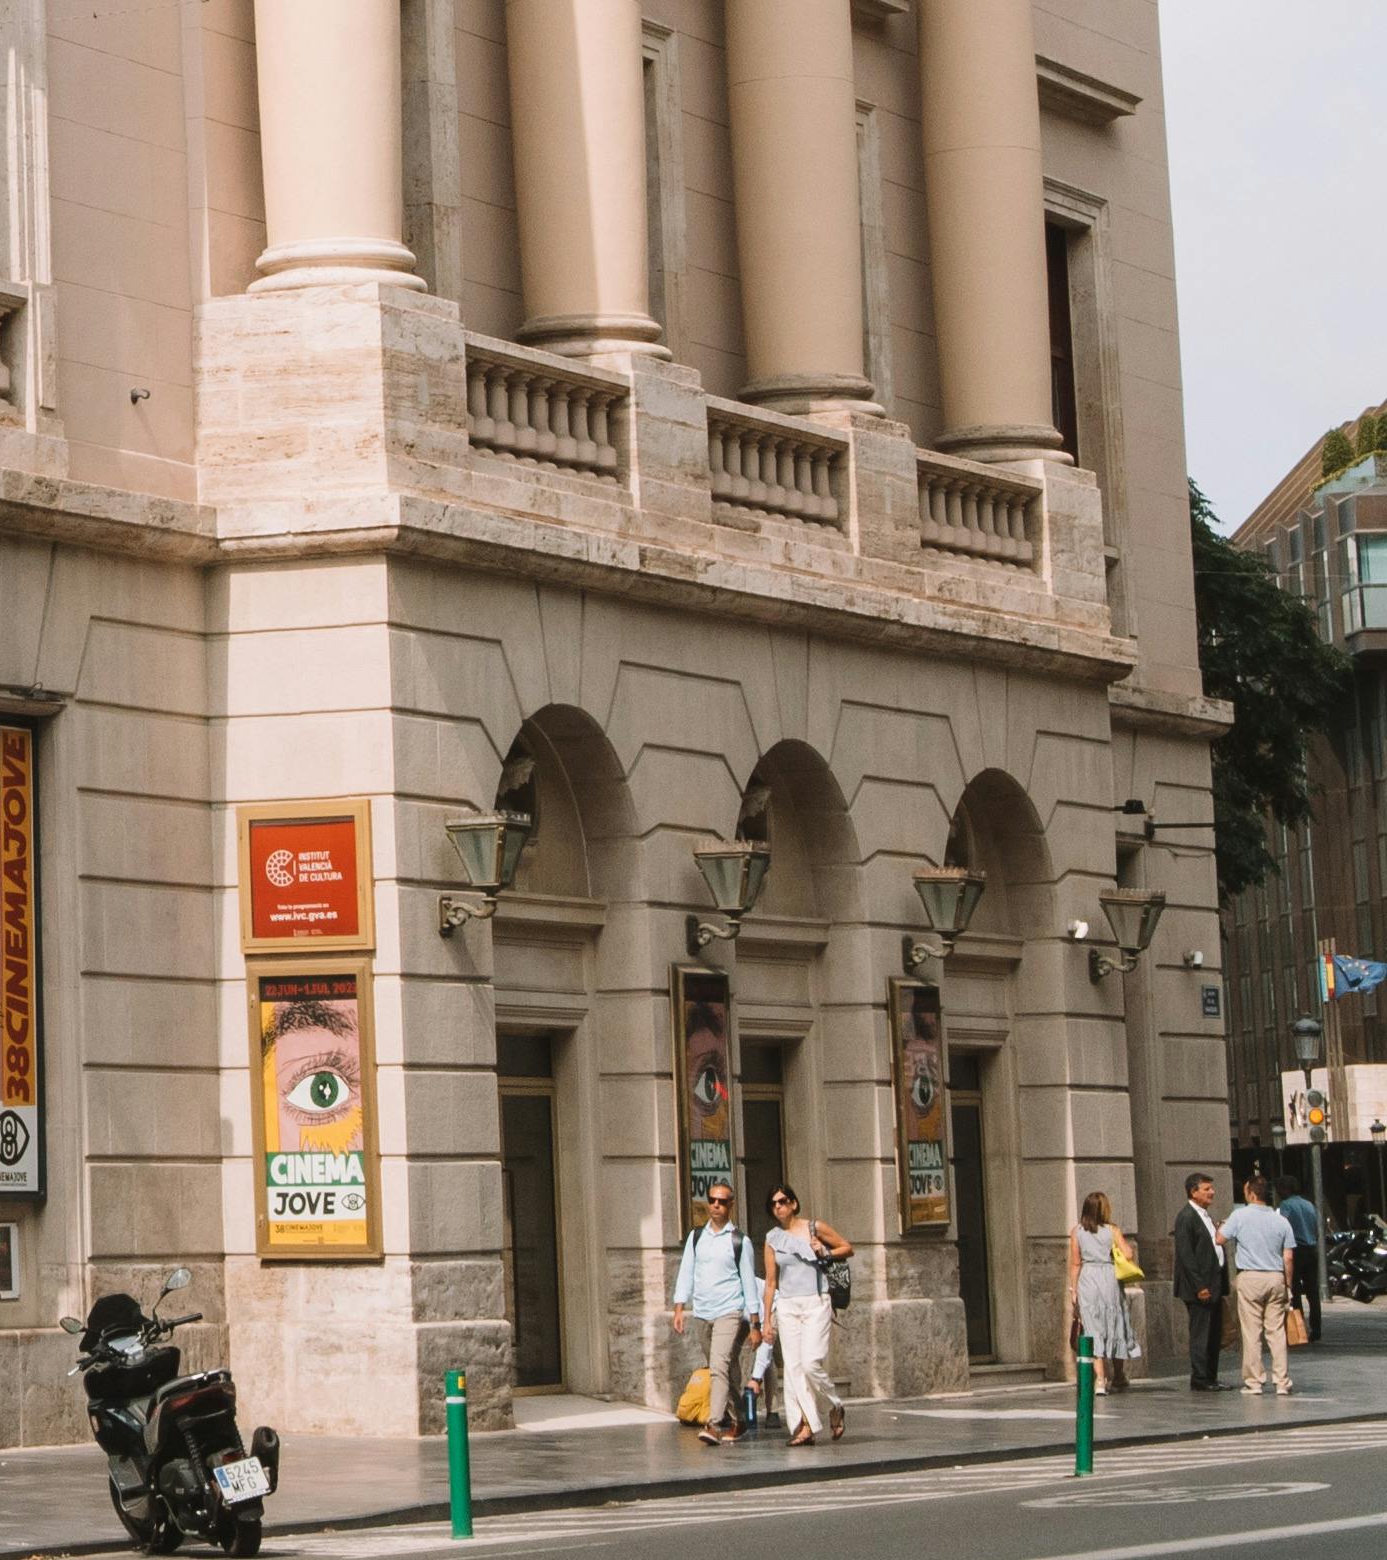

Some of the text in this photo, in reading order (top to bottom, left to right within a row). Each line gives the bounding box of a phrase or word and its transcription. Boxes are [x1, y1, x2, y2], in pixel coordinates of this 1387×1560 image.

[298, 851, 330, 861] INSTITUT
[299, 872, 342, 882] DE CULTURA
[270, 911, 338, 922] www.ivc.gva.es
[270, 1153, 365, 1185] CINEMA
[273, 1191, 336, 1216] JOVE
[225, 1460, 259, 1480] 5245
